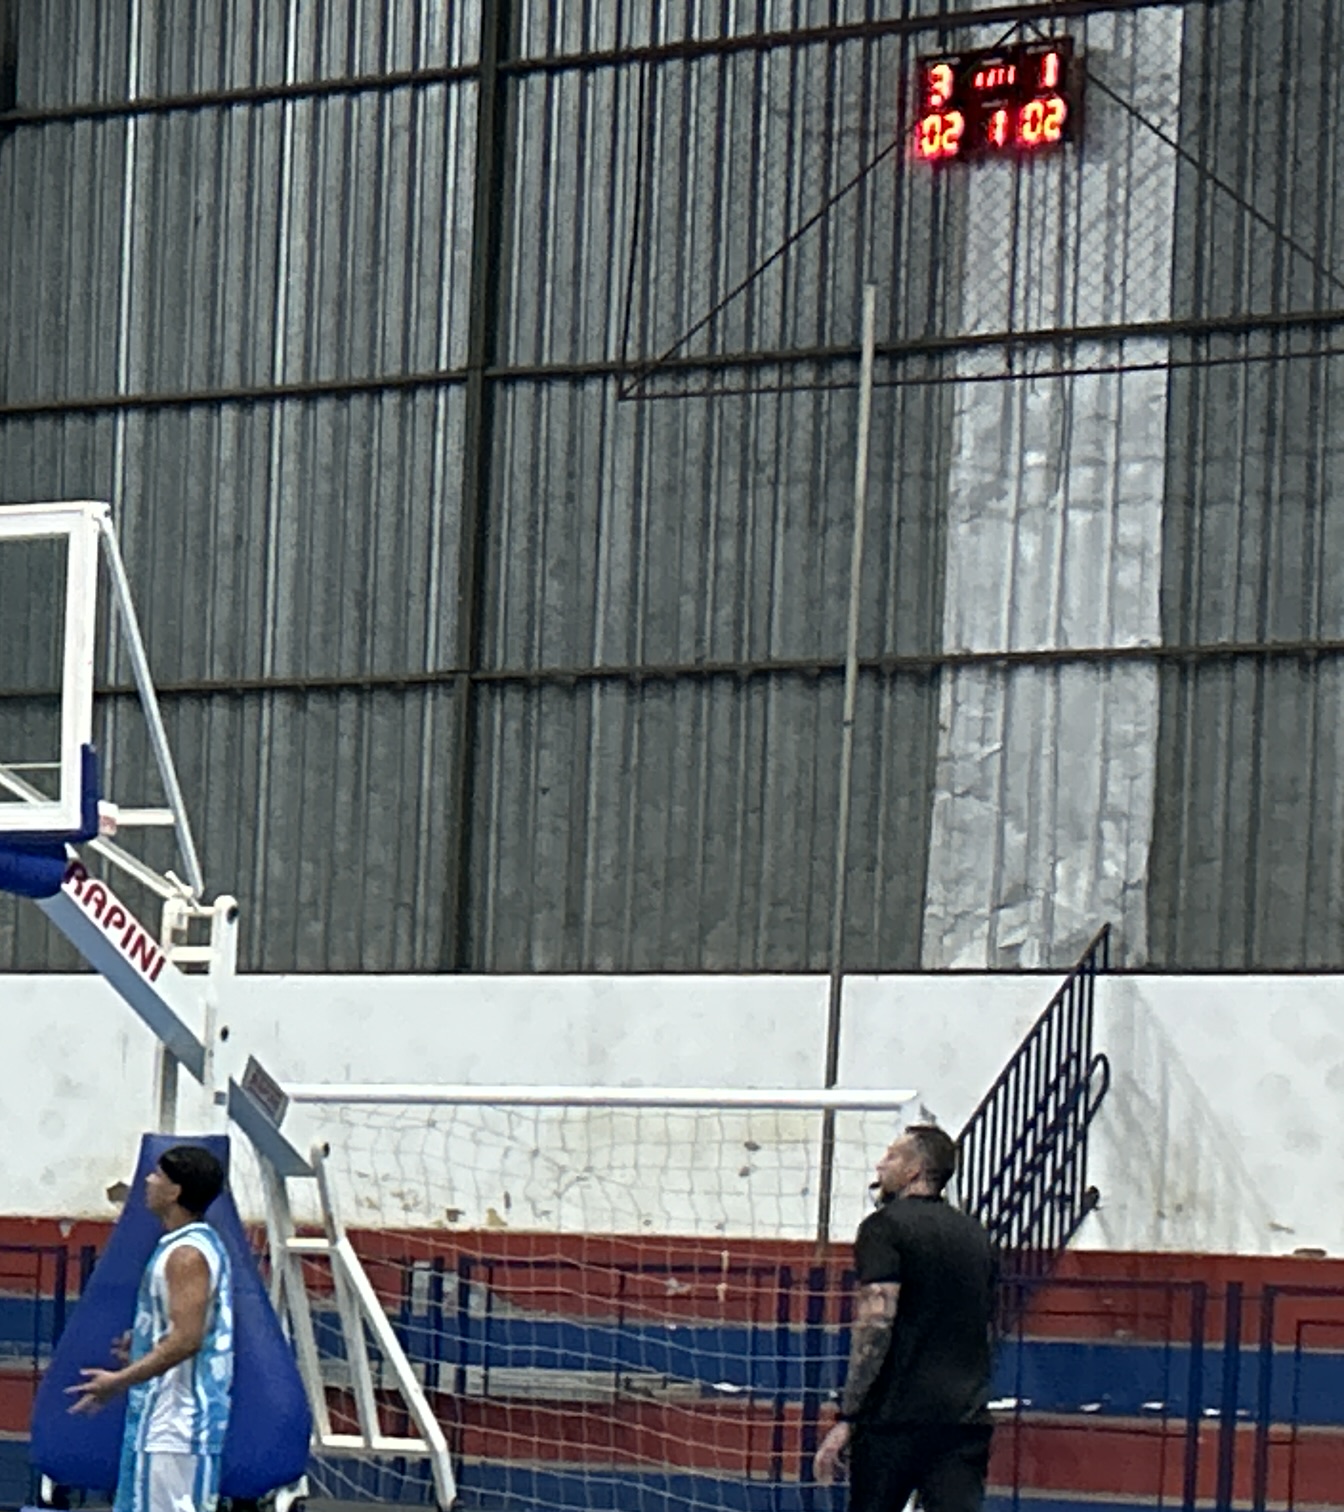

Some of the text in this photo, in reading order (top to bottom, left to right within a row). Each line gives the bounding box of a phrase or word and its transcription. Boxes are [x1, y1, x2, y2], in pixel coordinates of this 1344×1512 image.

[919, 110, 964, 157] 02
[1021, 98, 1066, 145] 02
[63, 860, 166, 983] RAPINI
